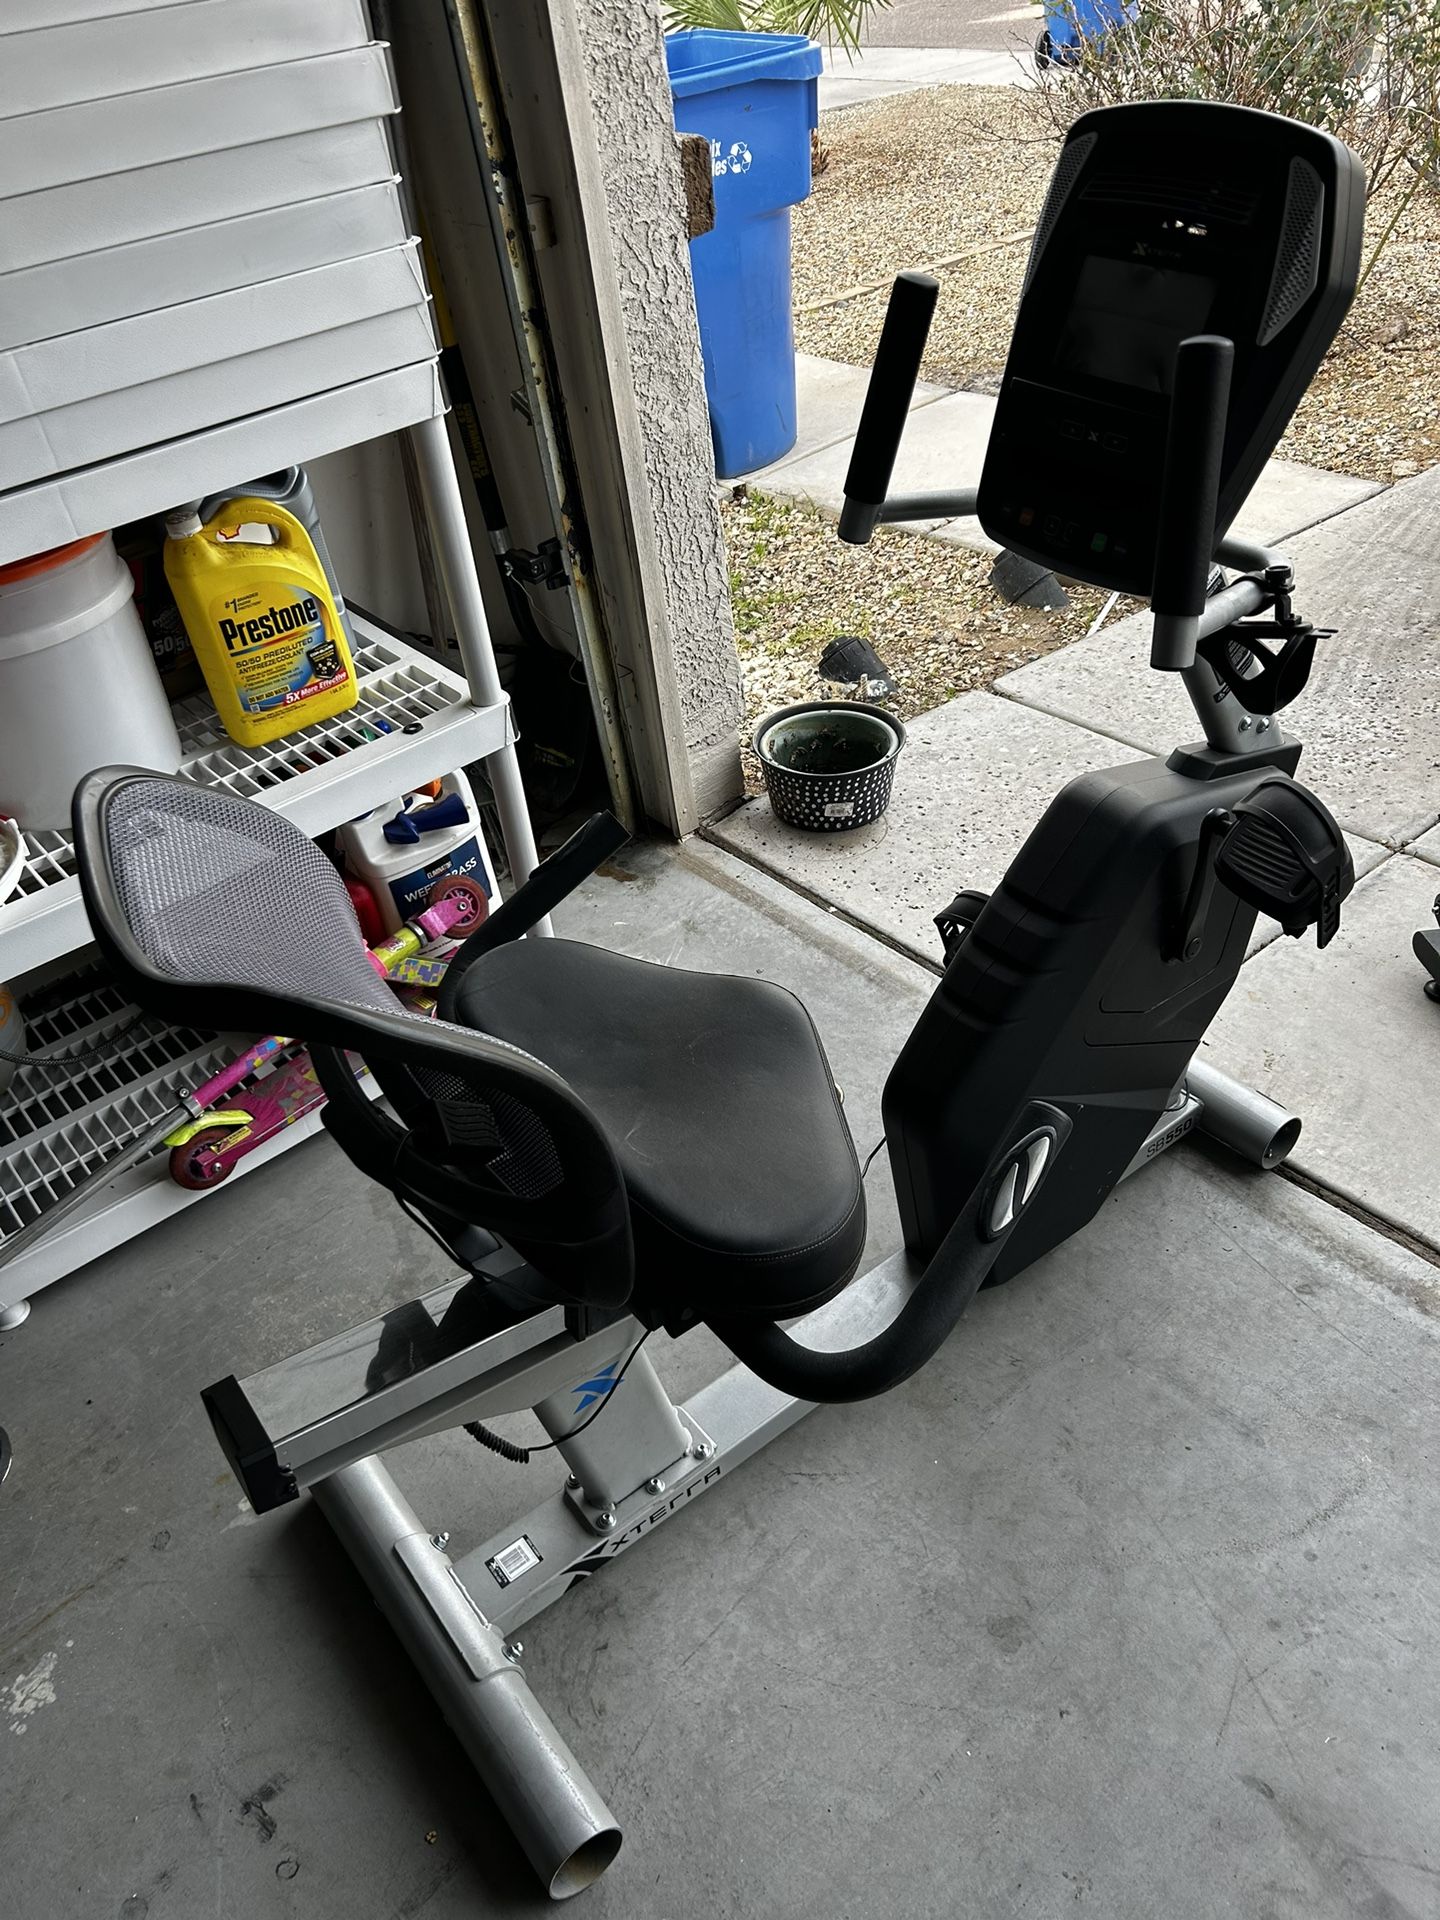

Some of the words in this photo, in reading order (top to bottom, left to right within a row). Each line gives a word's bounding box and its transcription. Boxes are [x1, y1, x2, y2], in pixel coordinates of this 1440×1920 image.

[224, 598, 238, 613] #1
[218, 597, 319, 651] Prestone
[263, 636, 314, 660] PREDILUTED
[300, 684, 318, 697] More
[319, 671, 347, 689] Effective
[1146, 1118, 1192, 1158] SB550
[611, 1465, 722, 1553] XTERRA
